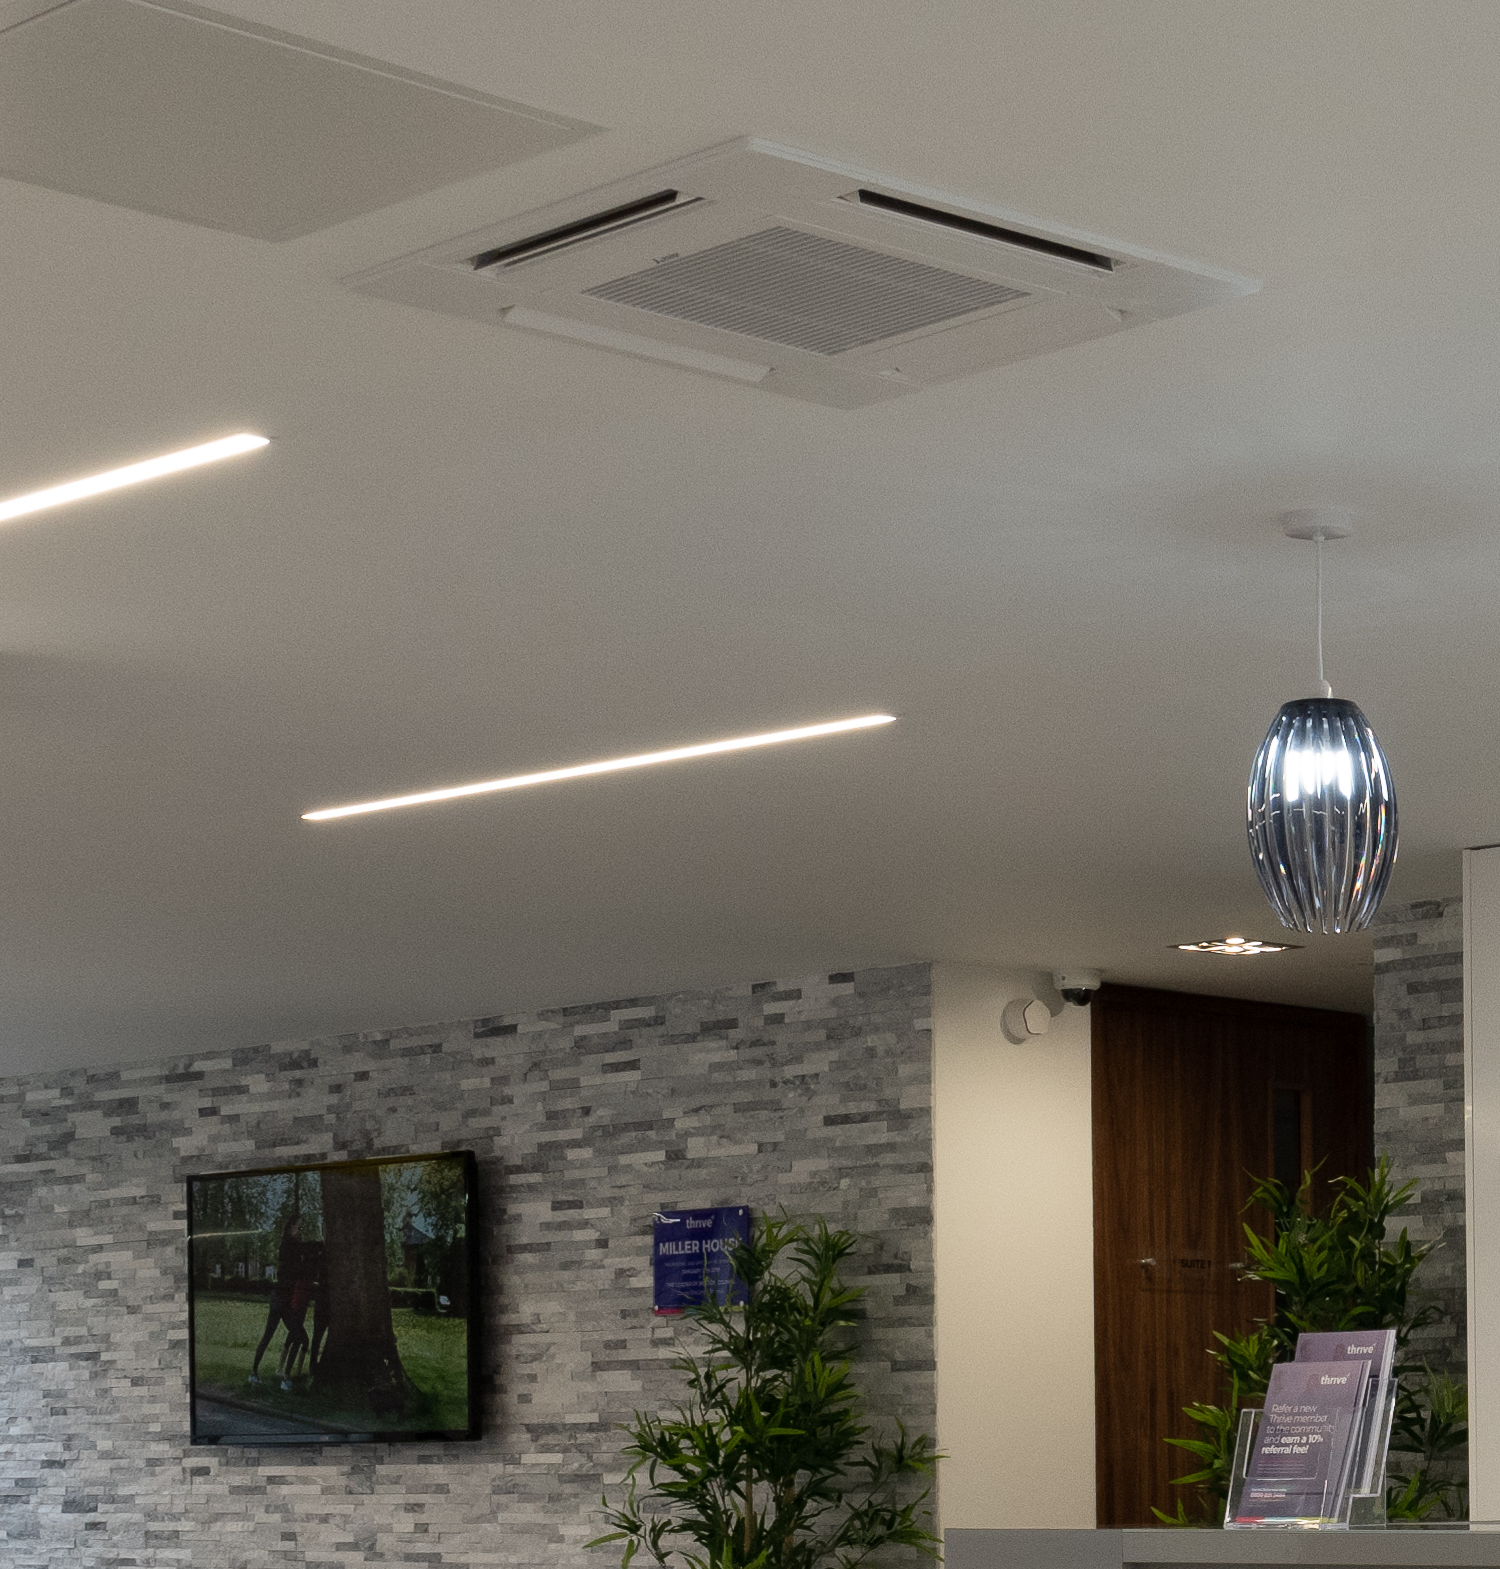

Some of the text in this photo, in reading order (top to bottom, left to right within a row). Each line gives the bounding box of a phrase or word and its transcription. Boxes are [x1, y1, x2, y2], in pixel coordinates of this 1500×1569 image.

[685, 1216, 713, 1229] thrive
[659, 1237, 743, 1255] MILLER HOUS
[1180, 1259, 1206, 1269] SUITE
[1347, 1343, 1374, 1355] thrive
[1320, 1374, 1347, 1385] thrive
[1271, 1403, 1292, 1413] Refer
[1299, 1405, 1318, 1413] new
[1266, 1425, 1275, 1434] to
[1276, 1425, 1289, 1434] the
[1263, 1434, 1281, 1444] and
[1281, 1436, 1300, 1444] earn
[1308, 1434, 1324, 1443] 10%
[1261, 1444, 1293, 1454] referral
